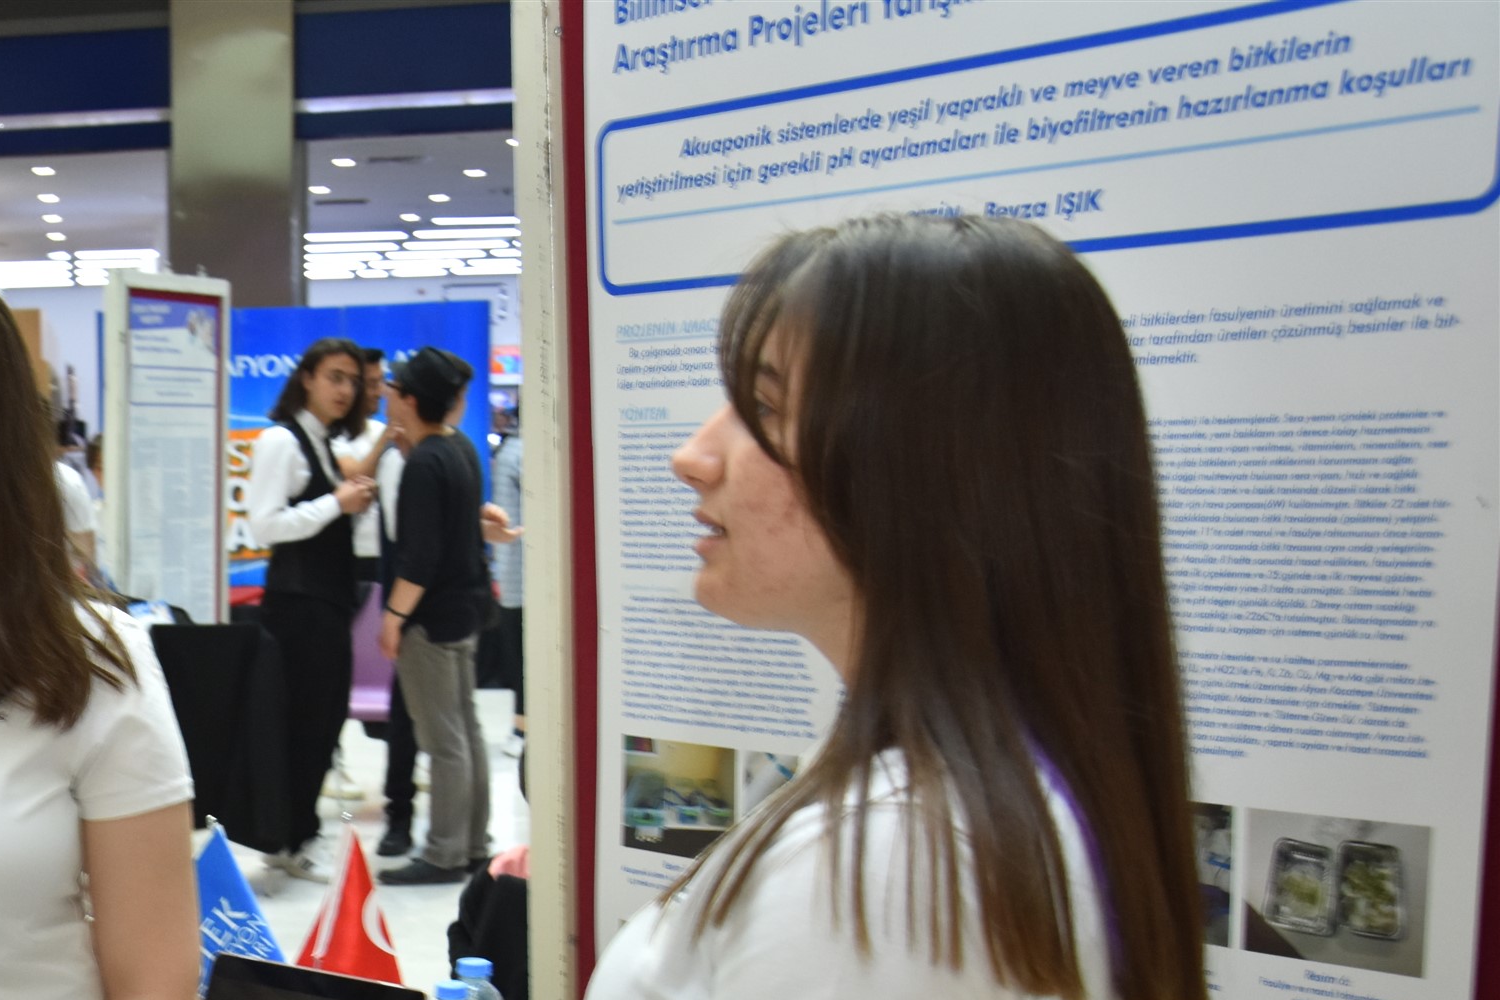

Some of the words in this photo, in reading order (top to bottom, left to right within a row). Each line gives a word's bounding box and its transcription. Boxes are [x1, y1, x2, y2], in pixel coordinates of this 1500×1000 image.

[612, 27, 738, 74] Araştırma
[748, 0, 869, 47] Projeleri
[680, 127, 771, 158] Akuaponik
[777, 109, 881, 144] sistemlerde
[888, 98, 930, 128] yeşil
[935, 83, 1024, 125] yapraklı
[1030, 83, 1057, 104] ve
[1063, 71, 1140, 100] meyve
[1148, 57, 1219, 85] veren
[1227, 32, 1353, 73] bitkilerin
[616, 170, 716, 202] yetiştirilmesi
[722, 159, 752, 189] için
[757, 150, 821, 186] gerekli
[826, 146, 854, 177] pH
[859, 130, 987, 170] ayarlamaları
[993, 121, 1019, 146] ile
[1026, 101, 1169, 145] biyofiltrenin
[1177, 78, 1329, 120] hazırlanma
[1337, 55, 1475, 100] koşulları
[1054, 189, 1104, 221] IŞIK
[1140, 309, 1204, 327] bitkilerden
[1209, 305, 1275, 323] fasulyenin
[1280, 300, 1343, 318] üretimini
[1349, 293, 1422, 316] sağlamak
[1426, 296, 1445, 307] ve
[1150, 329, 1213, 346] tarafından
[1217, 327, 1267, 343] üretilen
[1347, 317, 1405, 334] besinler
[1411, 314, 1430, 329] ile
